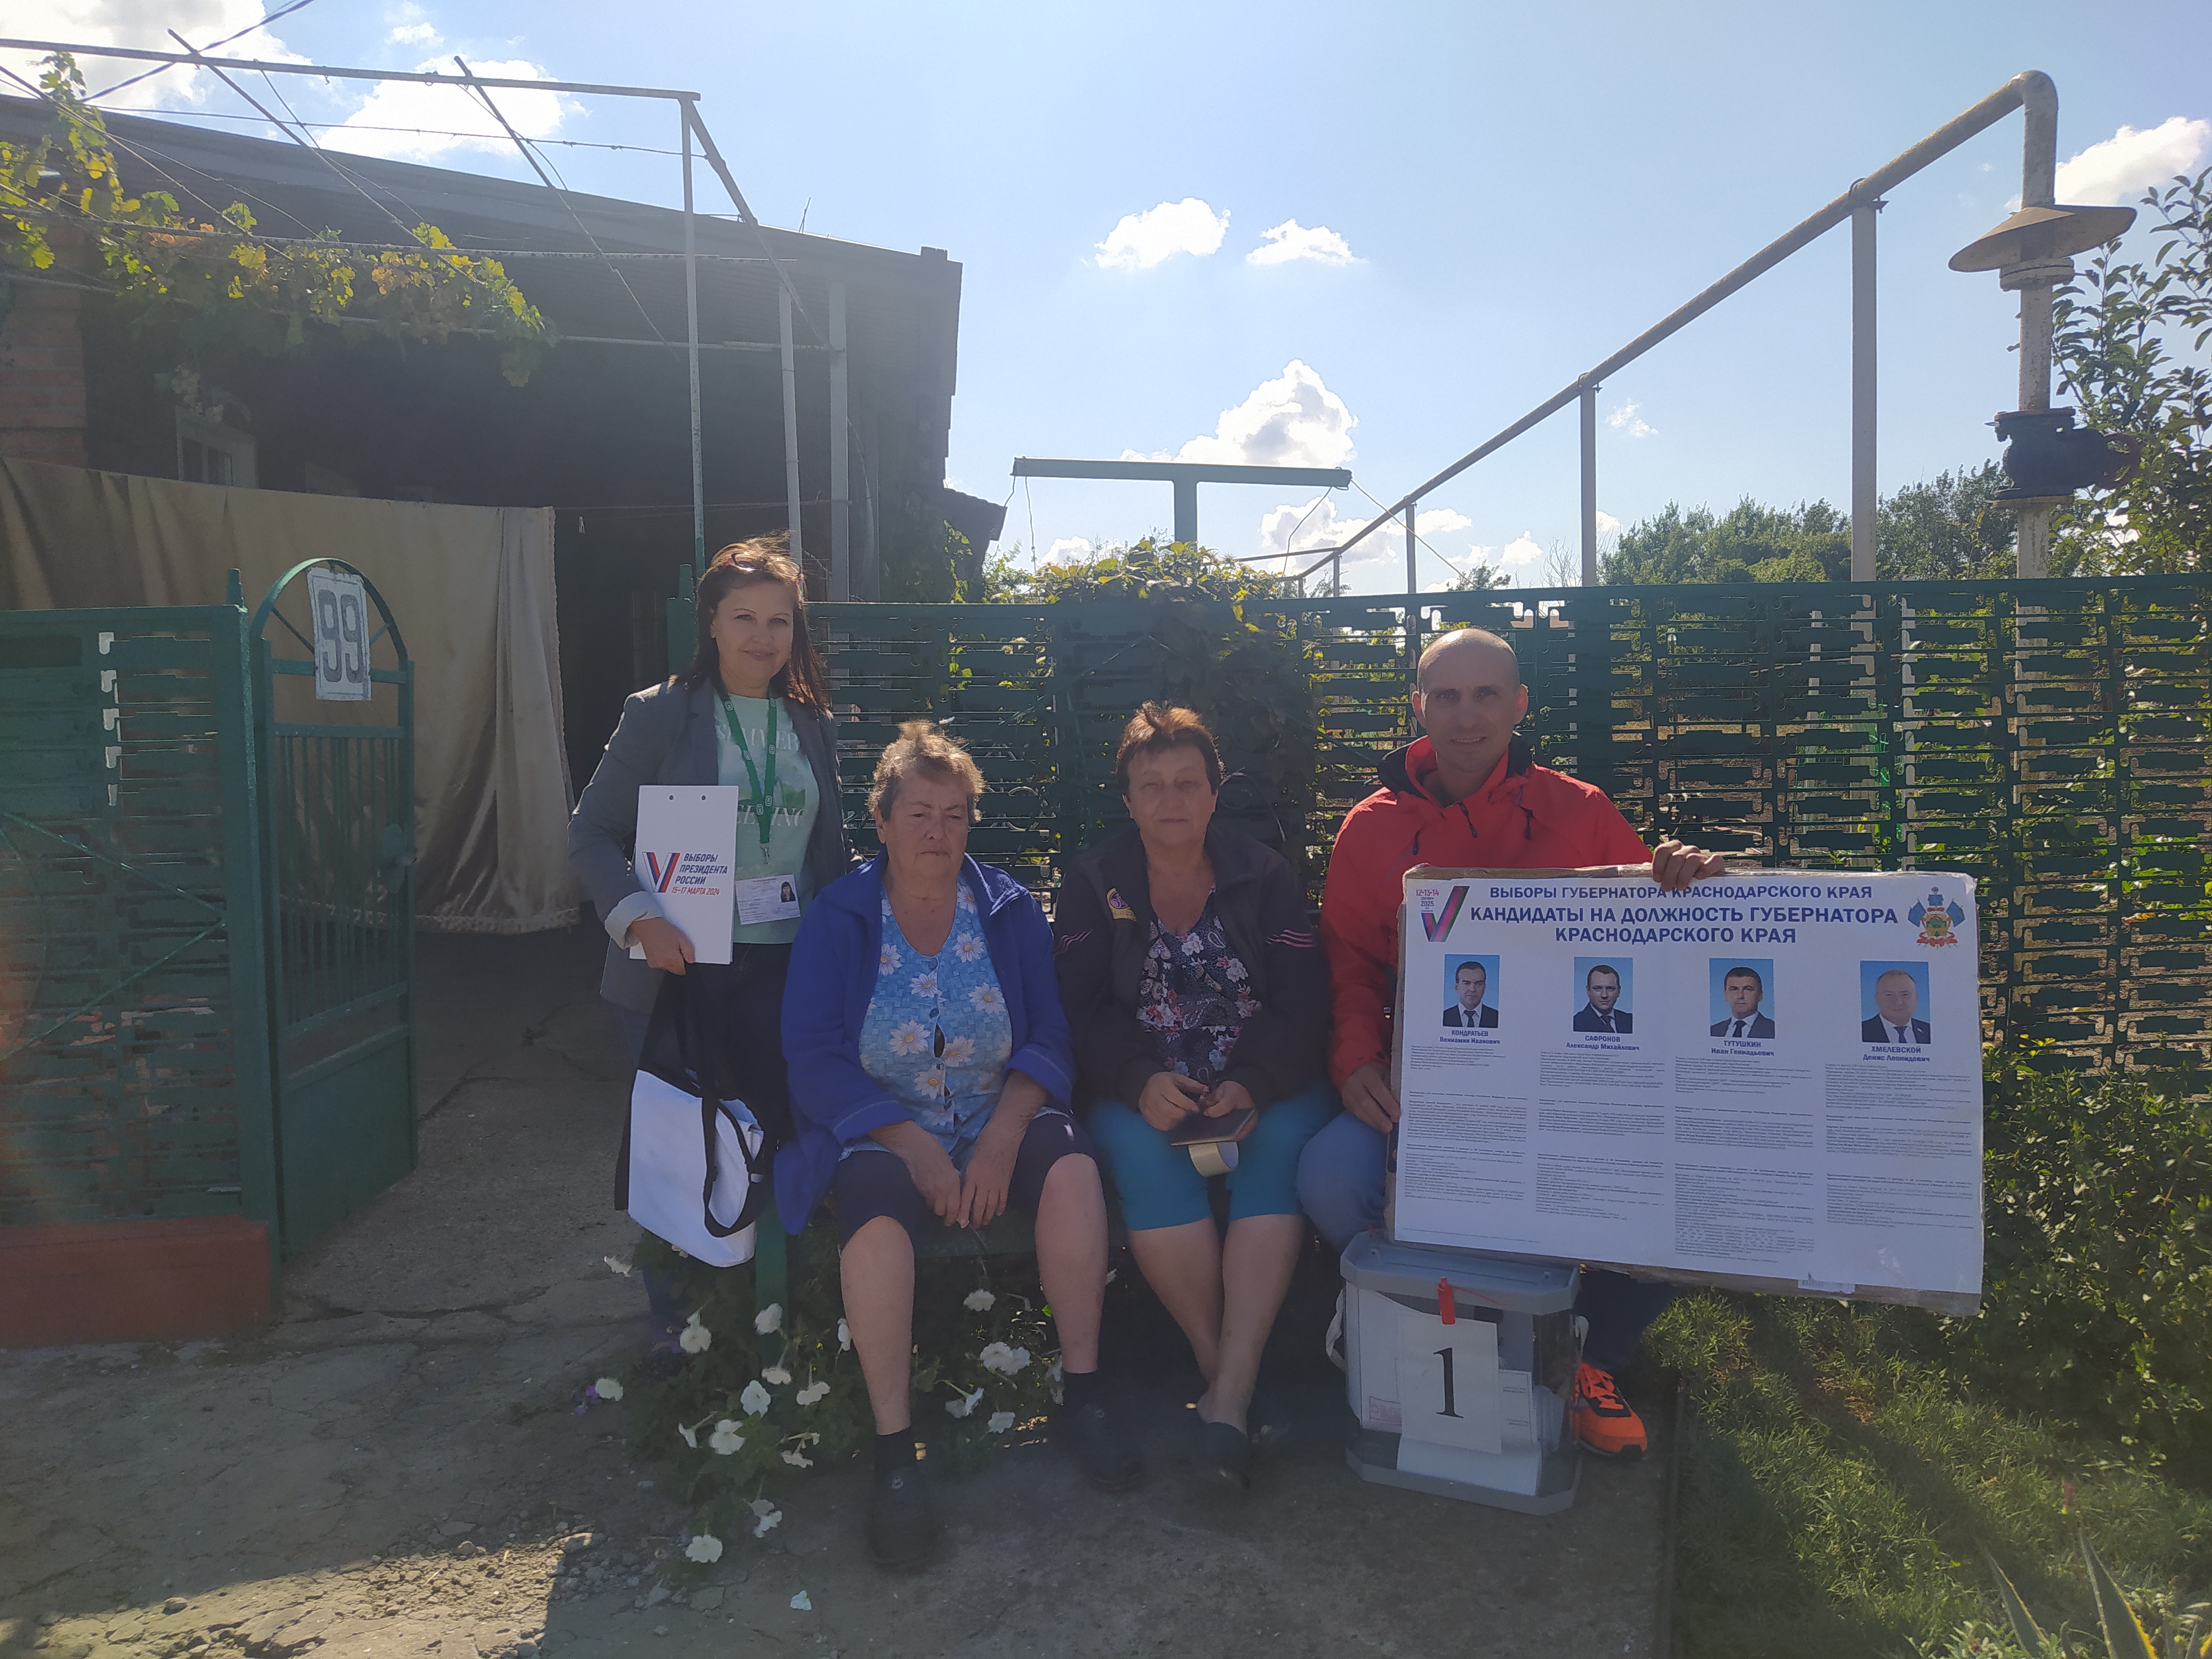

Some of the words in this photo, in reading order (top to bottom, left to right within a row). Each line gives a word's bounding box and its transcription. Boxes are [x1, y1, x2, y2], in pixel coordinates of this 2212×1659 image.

[319, 589, 364, 683] 99
[684, 853, 718, 862] ВЫБОРЫ
[679, 864, 728, 875] ПРЕЗИДЕНТА
[675, 876, 707, 885] РОССИИ
[1490, 887, 1557, 899] ВЫБОРЫ
[1561, 886, 1667, 899] ГУБЕРНАТОРА
[1671, 886, 1822, 900] КРАСНОДАРСКОГО
[1827, 886, 1872, 899] КРАЯ
[1470, 907, 1584, 924] КАНДИДАТЫ
[1590, 907, 1616, 922] НА
[1621, 907, 1744, 925] ДОЛЖНОСТЬ
[1750, 907, 1898, 924] ГУБЕРНАТОРА
[1555, 927, 1734, 945] КРАСНОДАРСКОГО
[1741, 928, 1796, 943] КРАЯ
[1730, 1048, 1775, 1056] Геннадьевич
[1871, 1045, 1921, 1053] ХМЕЛЕВСКОЙ
[1433, 1347, 1464, 1418] 1
